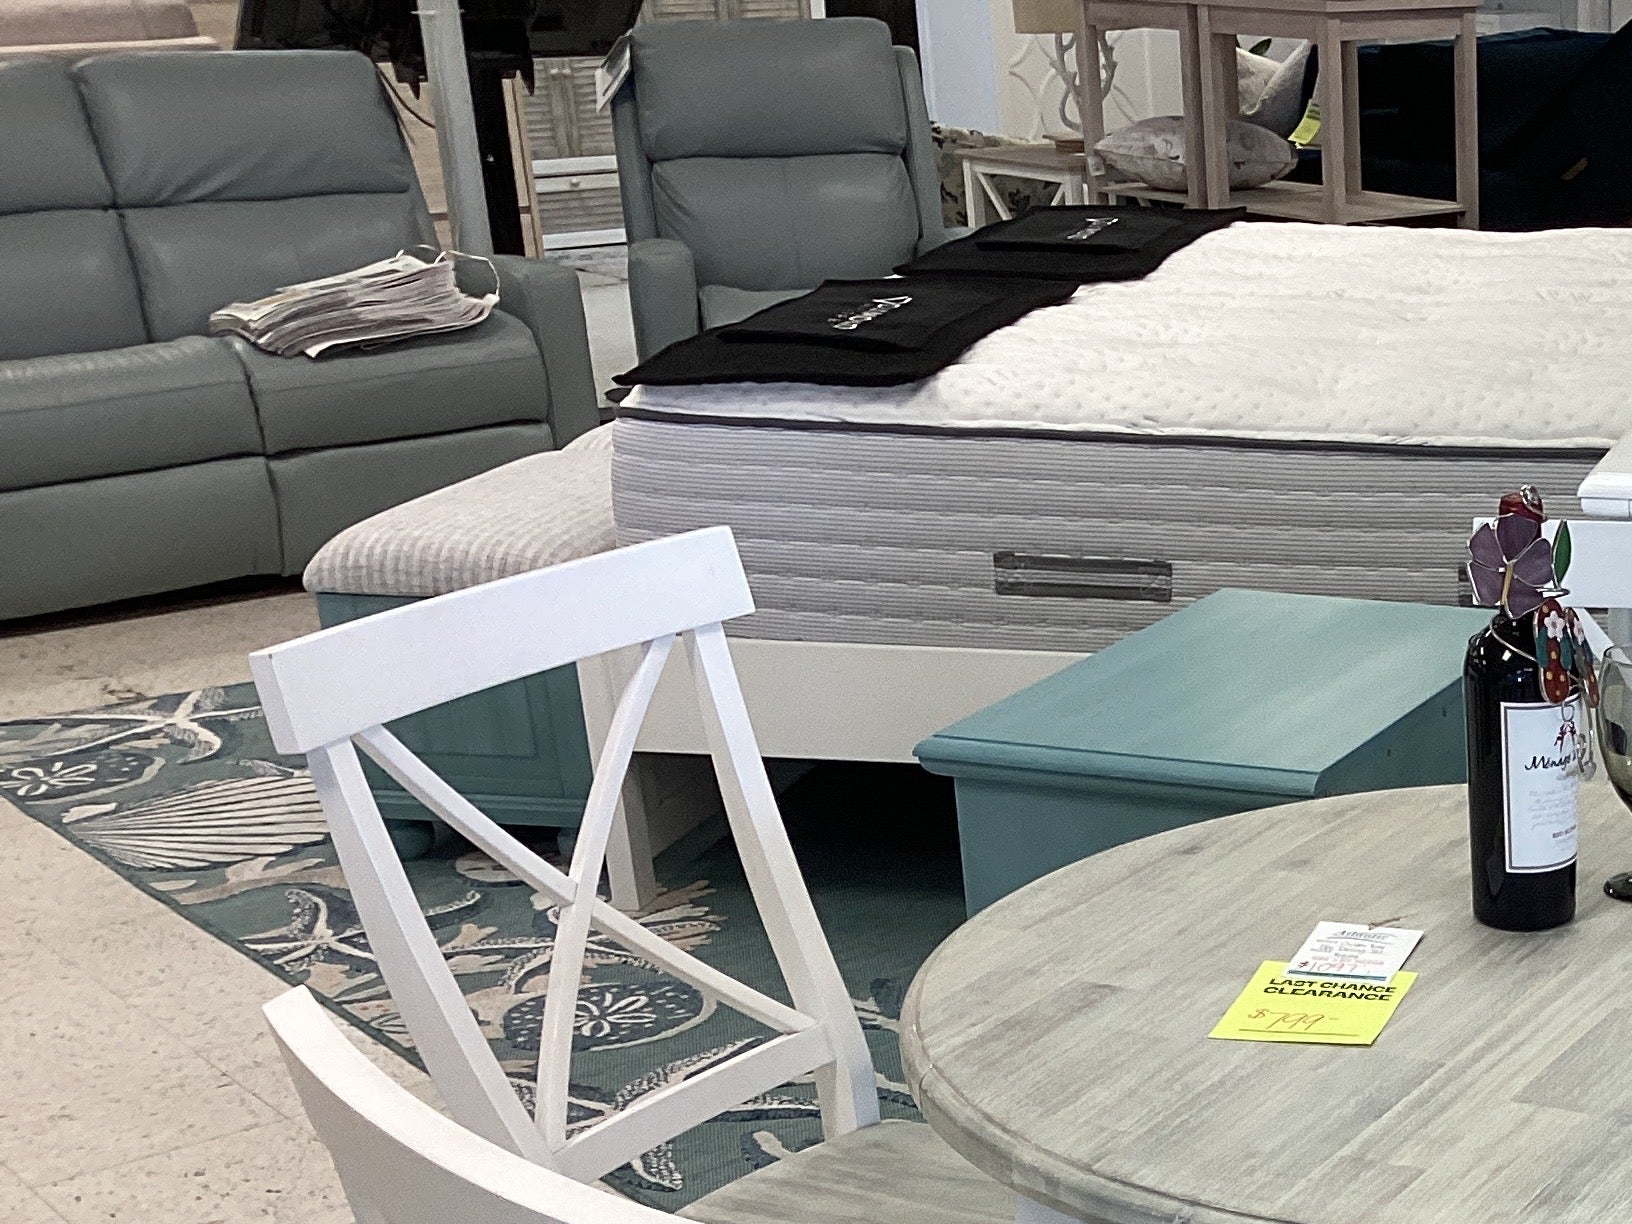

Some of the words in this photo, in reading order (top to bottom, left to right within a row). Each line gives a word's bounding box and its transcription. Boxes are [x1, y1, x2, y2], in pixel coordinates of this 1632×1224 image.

[1269, 978, 1317, 988] LAST
[1319, 981, 1397, 993] CHANCE
[1263, 986, 1394, 1001] CLEARANCE
